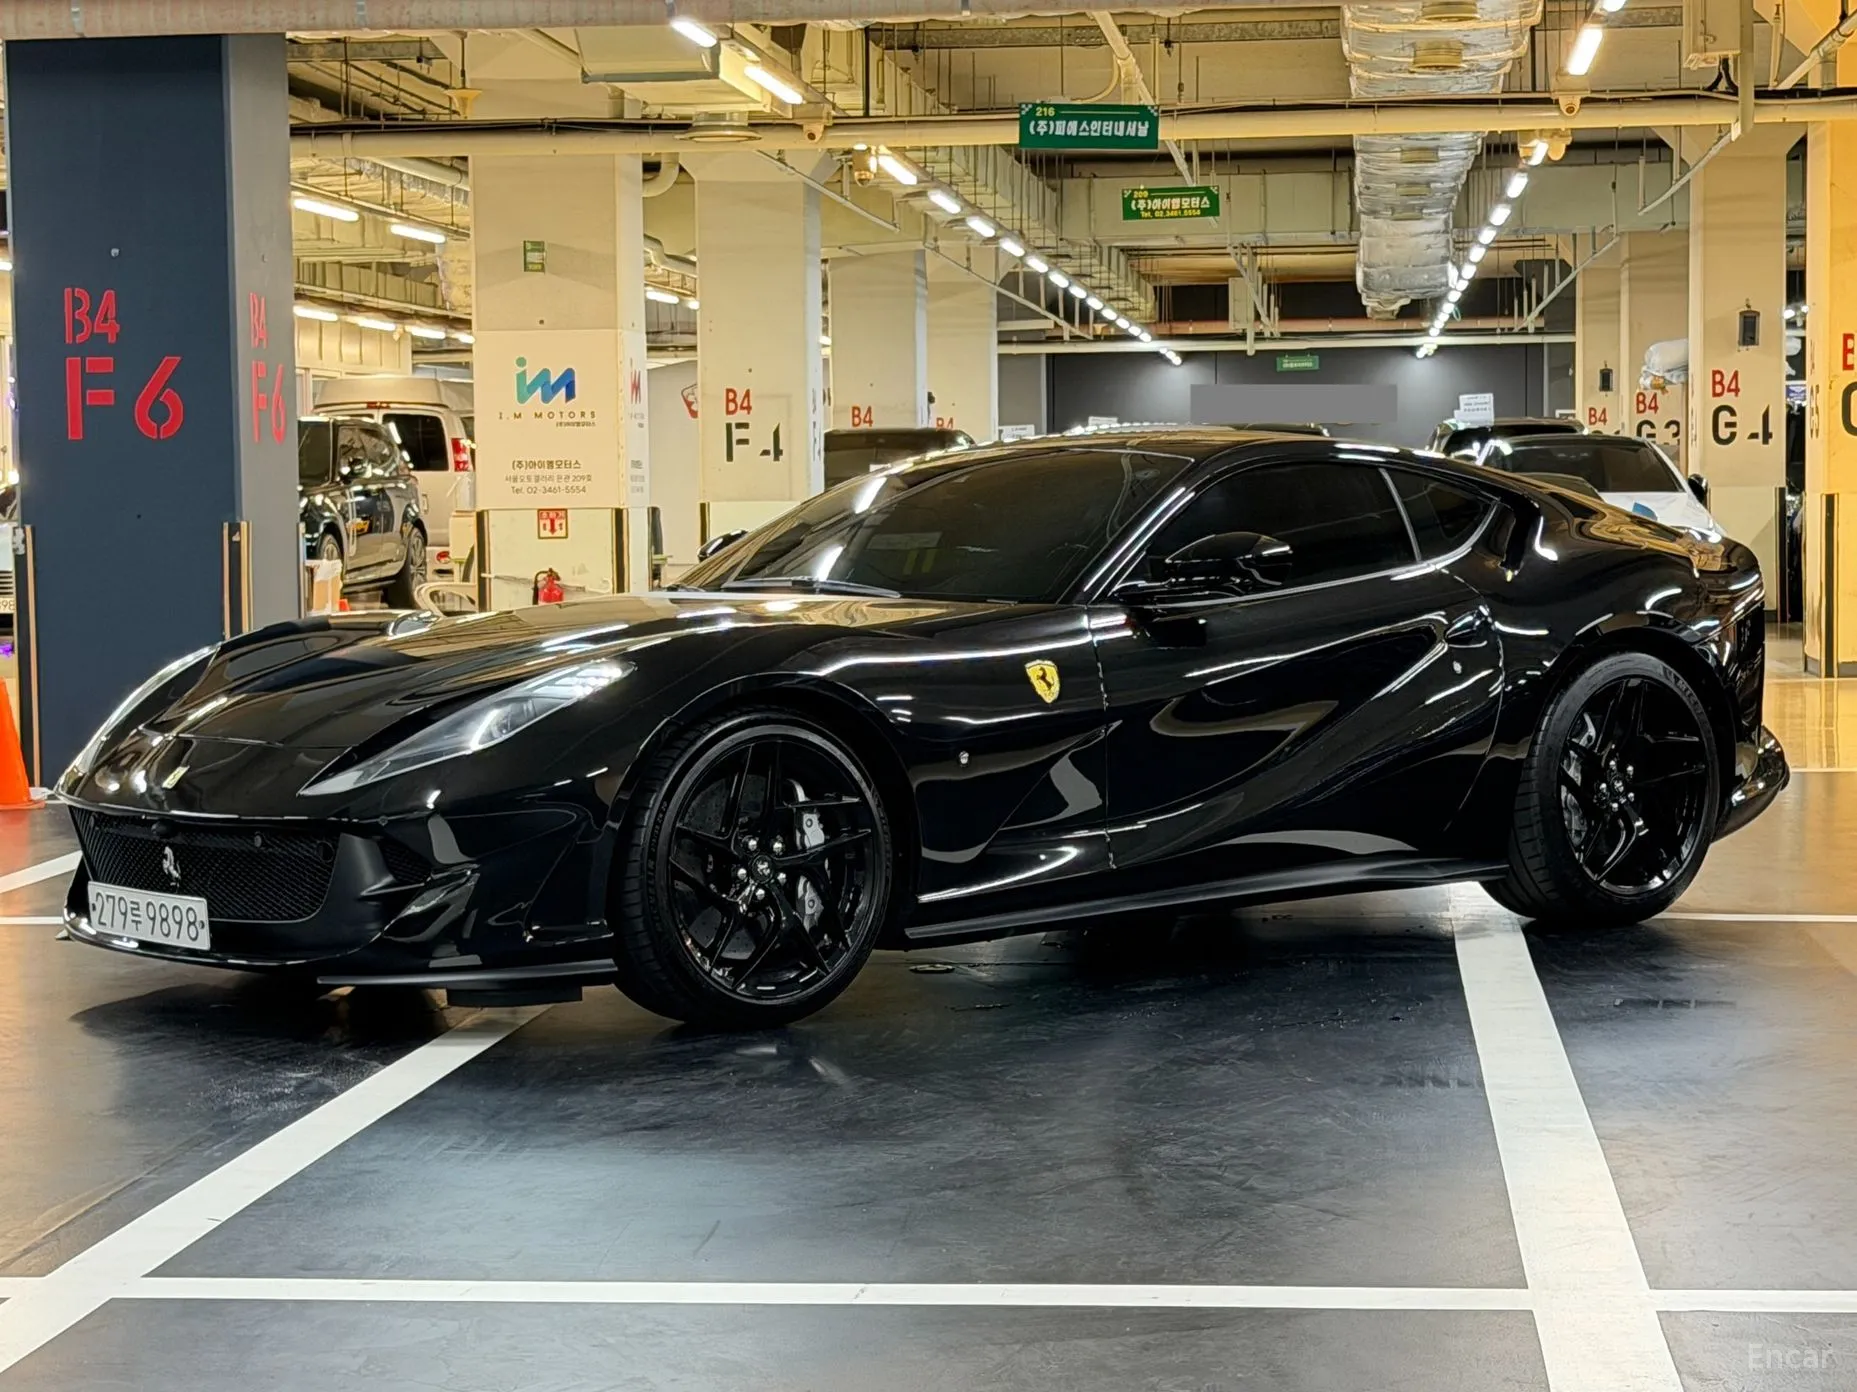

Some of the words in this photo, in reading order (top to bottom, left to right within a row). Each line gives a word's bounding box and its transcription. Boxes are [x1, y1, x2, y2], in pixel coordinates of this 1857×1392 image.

[1035, 107, 1055, 117] 216
[64, 287, 120, 344] B4
[250, 292, 267, 348] B4
[1711, 369, 1740, 398] B4
[725, 388, 752, 416] B4
[1636, 392, 1659, 415] B4
[534, 411, 596, 420] MOTORS
[851, 405, 874, 427] B4
[1588, 407, 1608, 426] B4
[526, 486, 587, 495] 02-3461-5554
[96, 892, 199, 942] 279루9898
